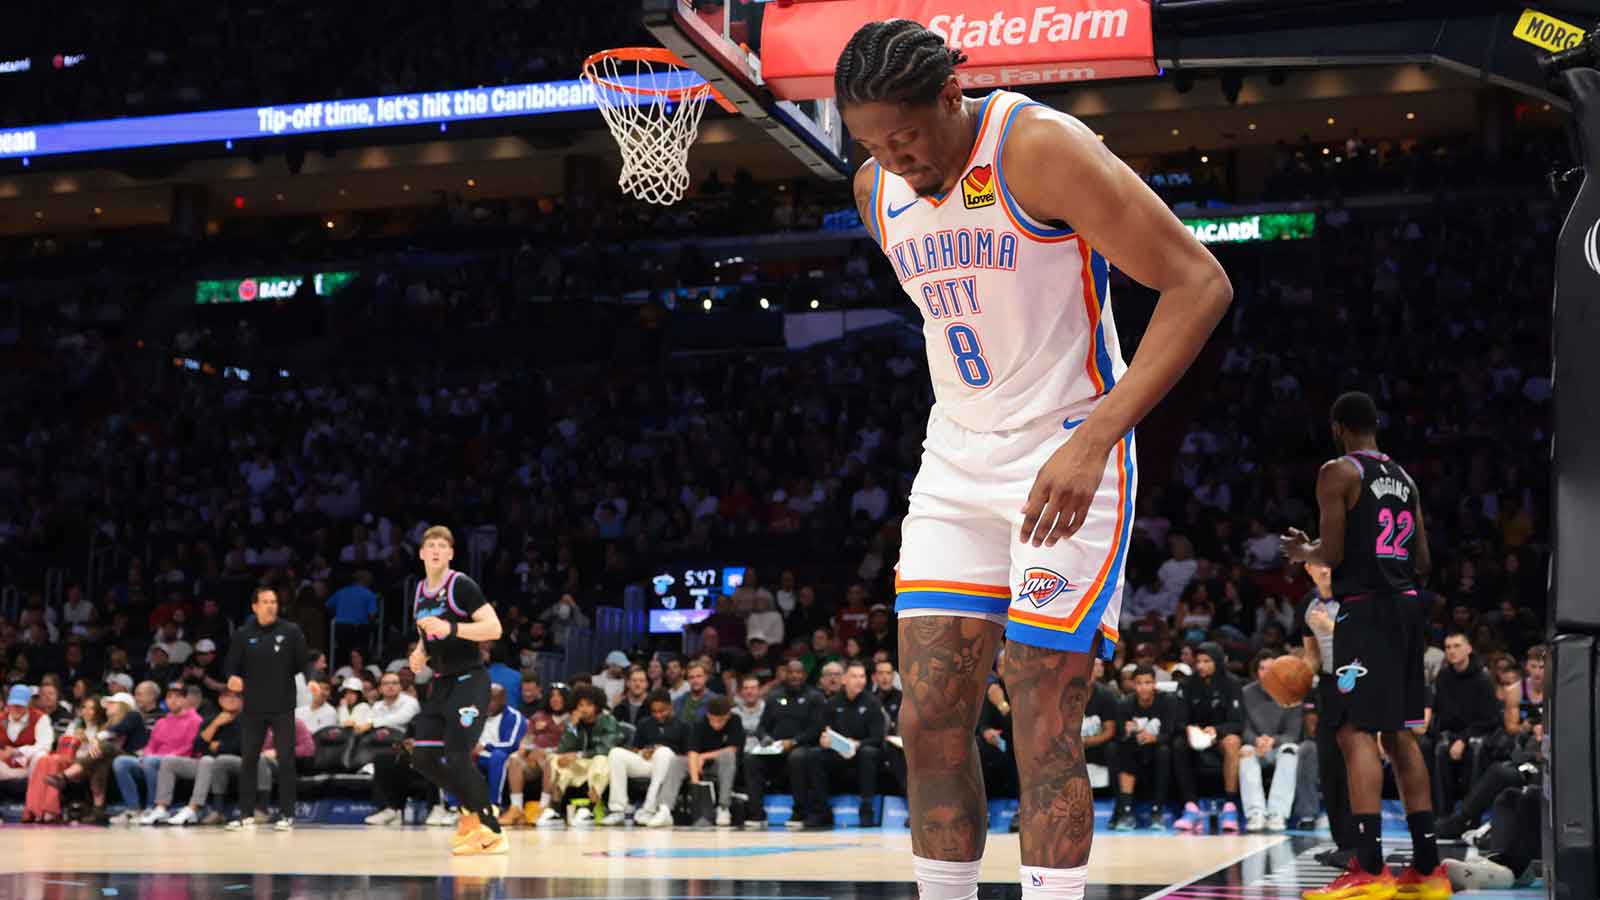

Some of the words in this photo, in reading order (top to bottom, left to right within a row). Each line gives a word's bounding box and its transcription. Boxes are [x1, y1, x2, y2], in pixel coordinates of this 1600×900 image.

[1001, 65, 1096, 85] Farm
[257, 102, 322, 134] Tip-off
[325, 102, 374, 126] time,
[377, 96, 419, 122] let's
[422, 92, 451, 118] hit
[454, 90, 488, 115] the
[491, 83, 595, 112] Caribbean
[0, 131, 36, 153] ean
[887, 228, 1018, 283] KLAHOMA
[920, 276, 982, 319] CITY
[945, 322, 993, 389] 8
[1370, 477, 1410, 503] WIGGINS
[1375, 507, 1415, 560] 22
[685, 569, 716, 587] 5:47
[1019, 578, 1057, 597] OKC
